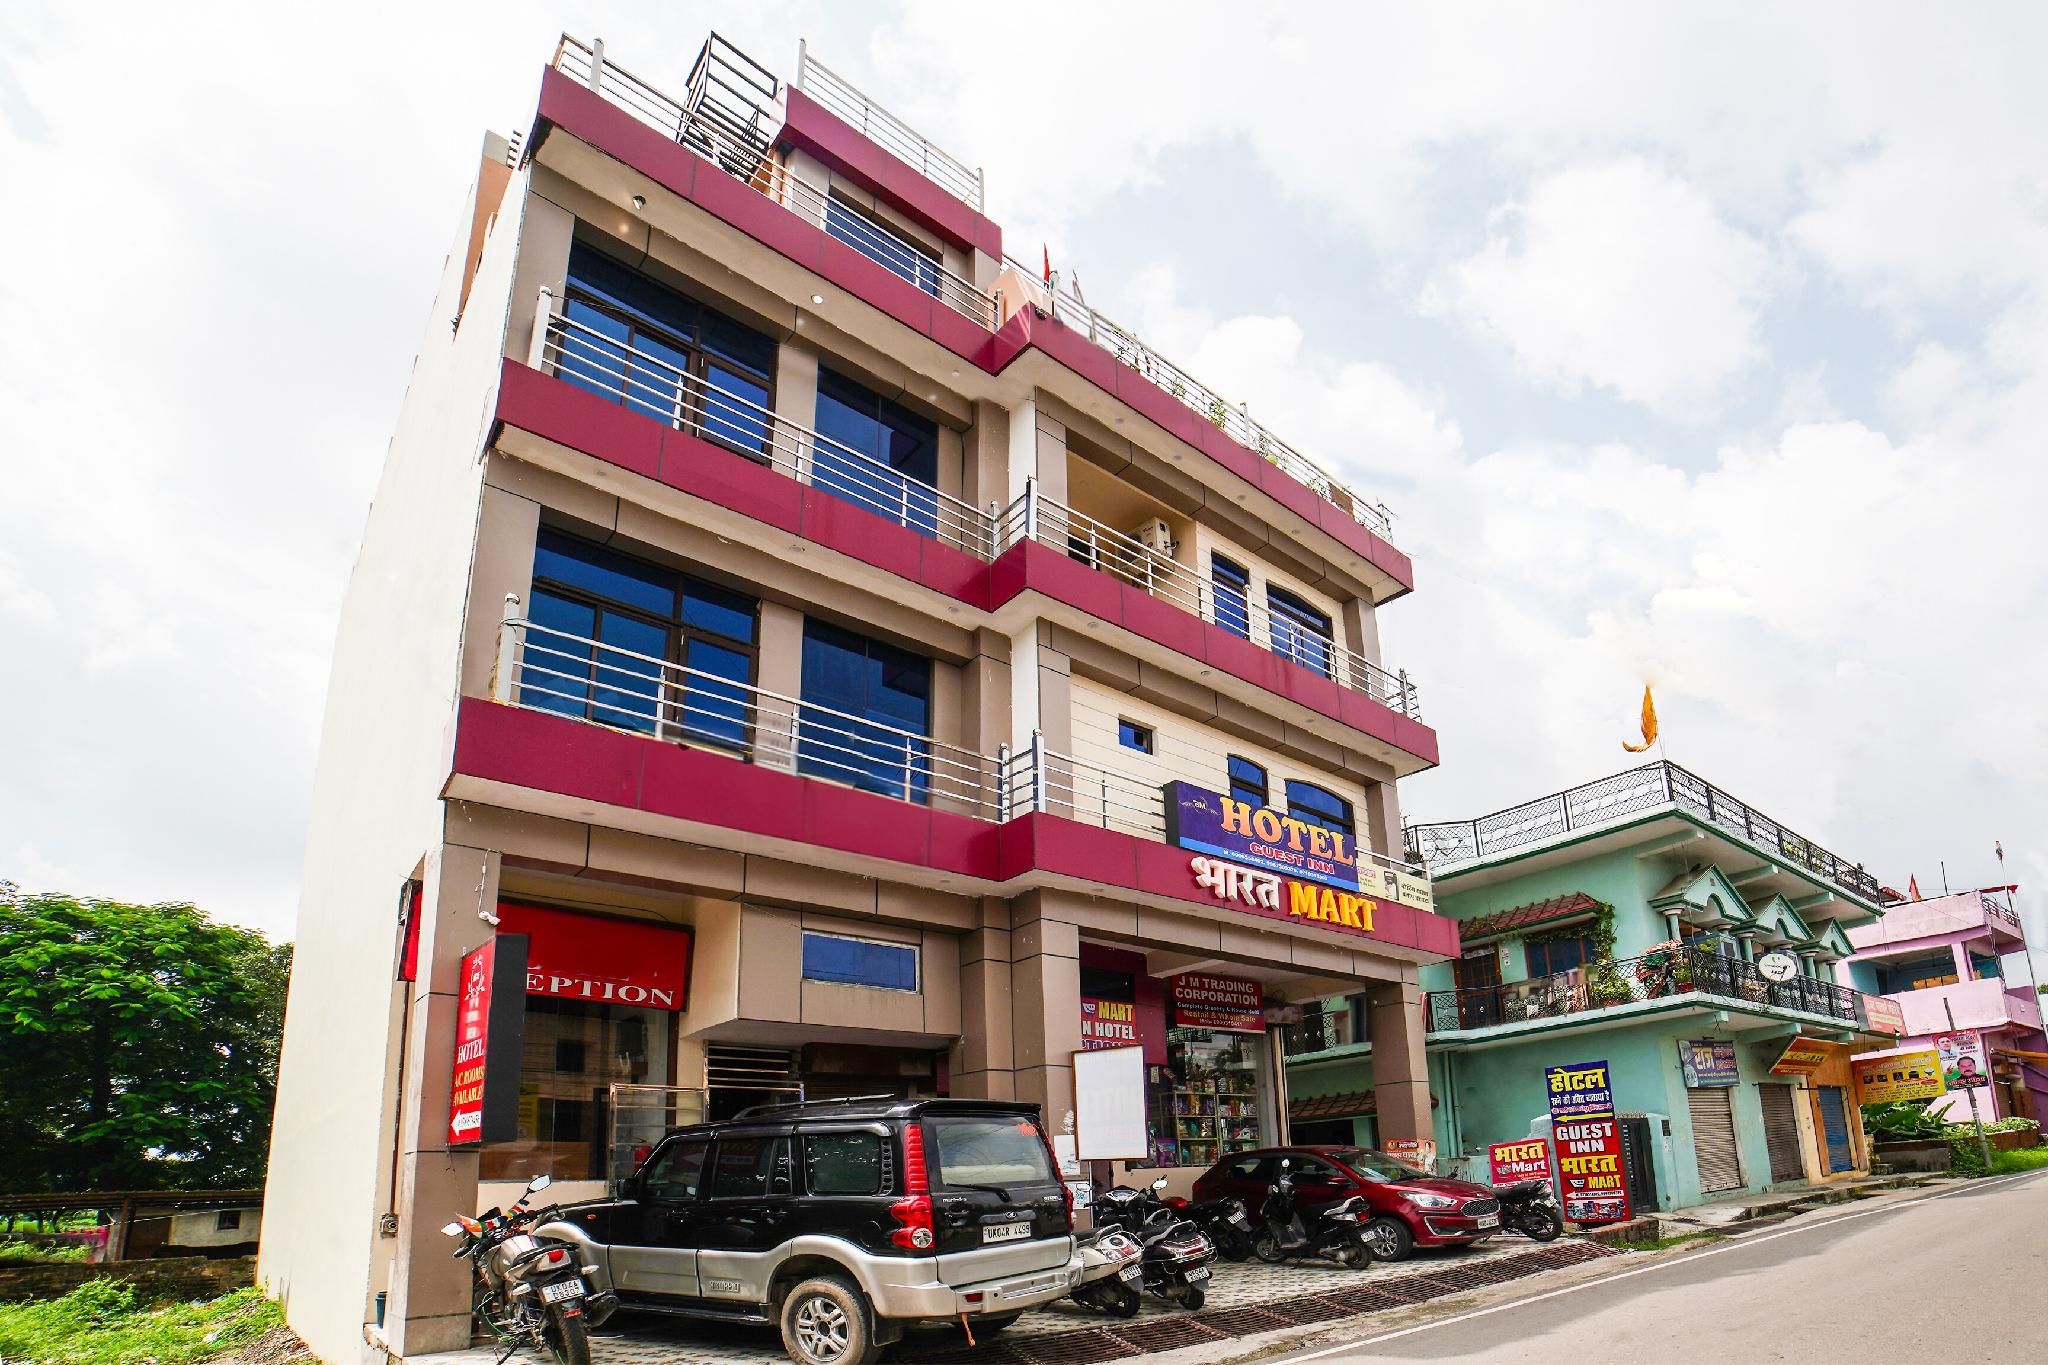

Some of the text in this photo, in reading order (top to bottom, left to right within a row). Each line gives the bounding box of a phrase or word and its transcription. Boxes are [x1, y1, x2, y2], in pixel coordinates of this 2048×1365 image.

[1220, 797, 1354, 867] HOTEL
[1250, 843, 1304, 867] GUEST
[1307, 858, 1335, 874] INN
[1190, 856, 1282, 910] भारत
[1287, 881, 1377, 932] MART
[1178, 976, 1254, 993] J M TRADING
[1175, 988, 1258, 1006] CORPORATION
[1099, 1001, 1133, 1022] MART
[1095, 1022, 1136, 1040] HOTEL
[457, 1039, 484, 1065] HOTEL
[1548, 1067, 1605, 1093] होटल
[452, 1085, 484, 1107] AVAILABLE
[1556, 1122, 1613, 1141] GUEST
[1494, 1142, 1545, 1163] भारत
[1569, 1139, 1605, 1154] INN
[1511, 1160, 1547, 1173] Mart
[1561, 1154, 1618, 1175] भारत
[1588, 1175, 1621, 1189] MART
